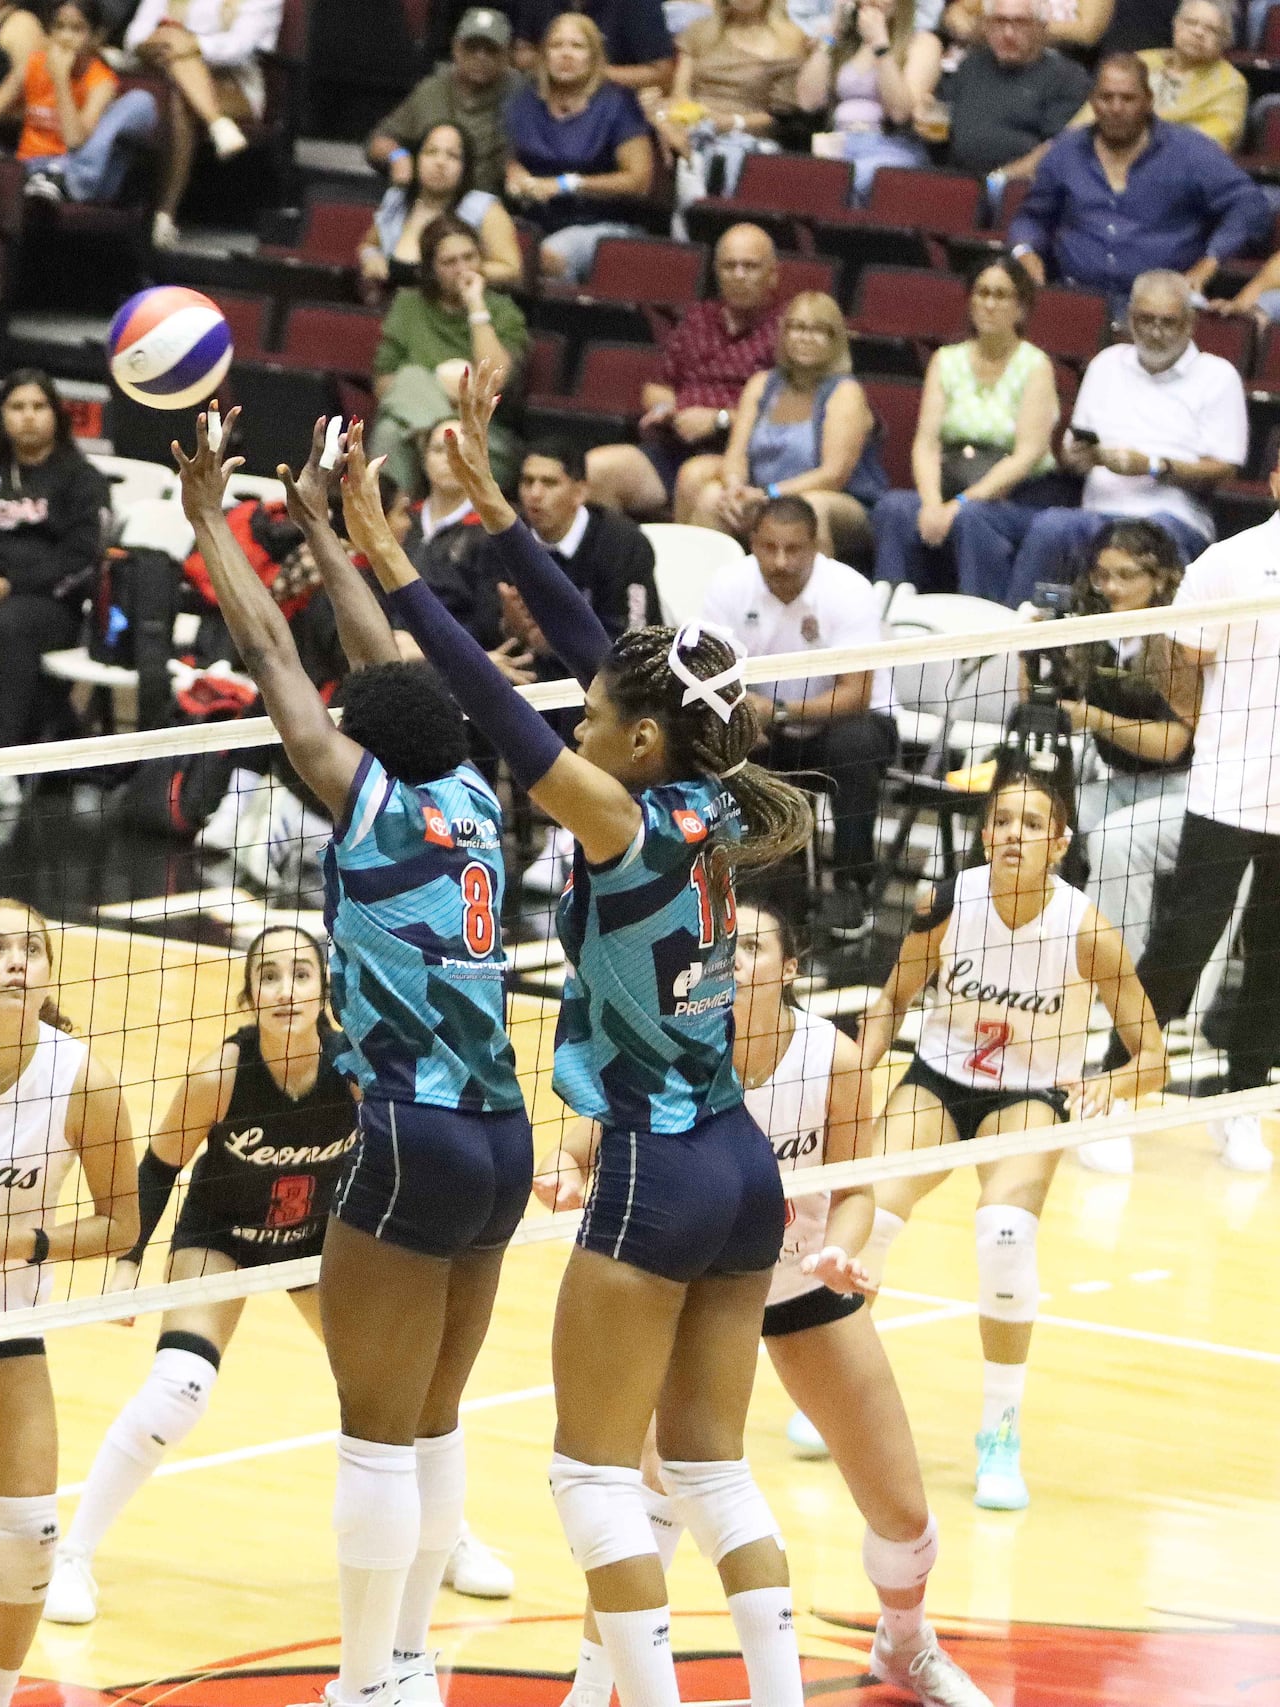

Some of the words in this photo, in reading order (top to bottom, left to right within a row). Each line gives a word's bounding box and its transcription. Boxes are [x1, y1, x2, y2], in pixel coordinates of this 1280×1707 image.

[461, 860, 495, 959] 8
[945, 959, 1062, 1015] Leonas
[963, 1018, 1014, 1080] 2
[224, 1127, 358, 1167] Leonas
